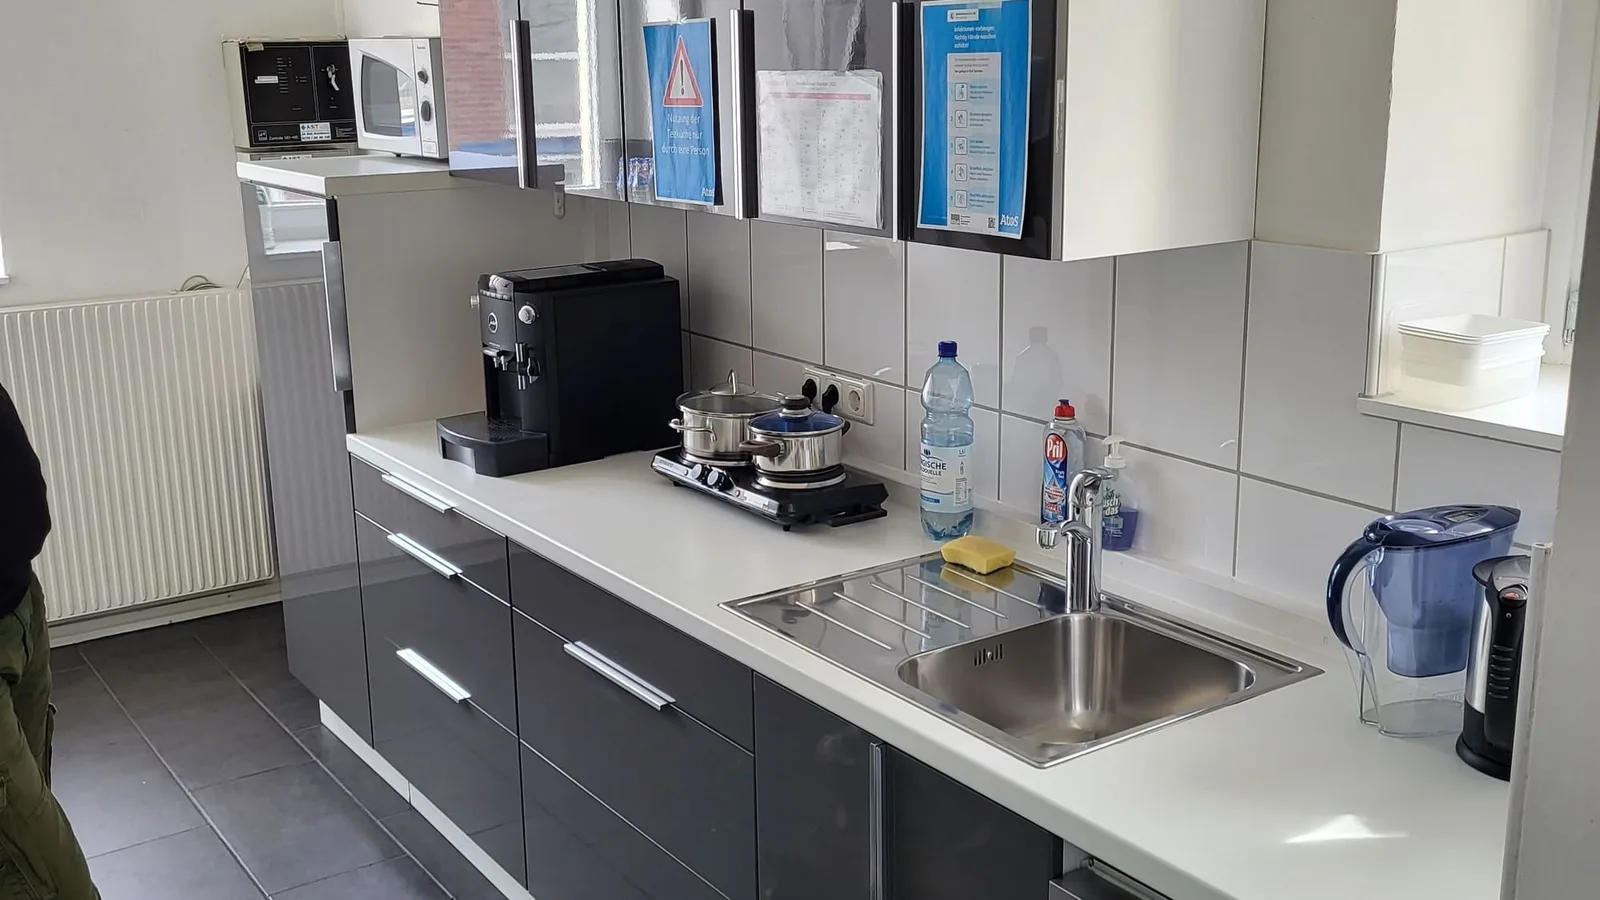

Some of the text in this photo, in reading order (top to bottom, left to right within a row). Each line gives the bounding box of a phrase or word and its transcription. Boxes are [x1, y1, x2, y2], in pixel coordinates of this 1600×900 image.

[668, 113, 701, 125] Nutzung der
[693, 131, 702, 140] nur
[662, 143, 677, 154] durch
[690, 145, 709, 155] Person
[1046, 438, 1064, 459] Pril
[1105, 506, 1119, 516] das
